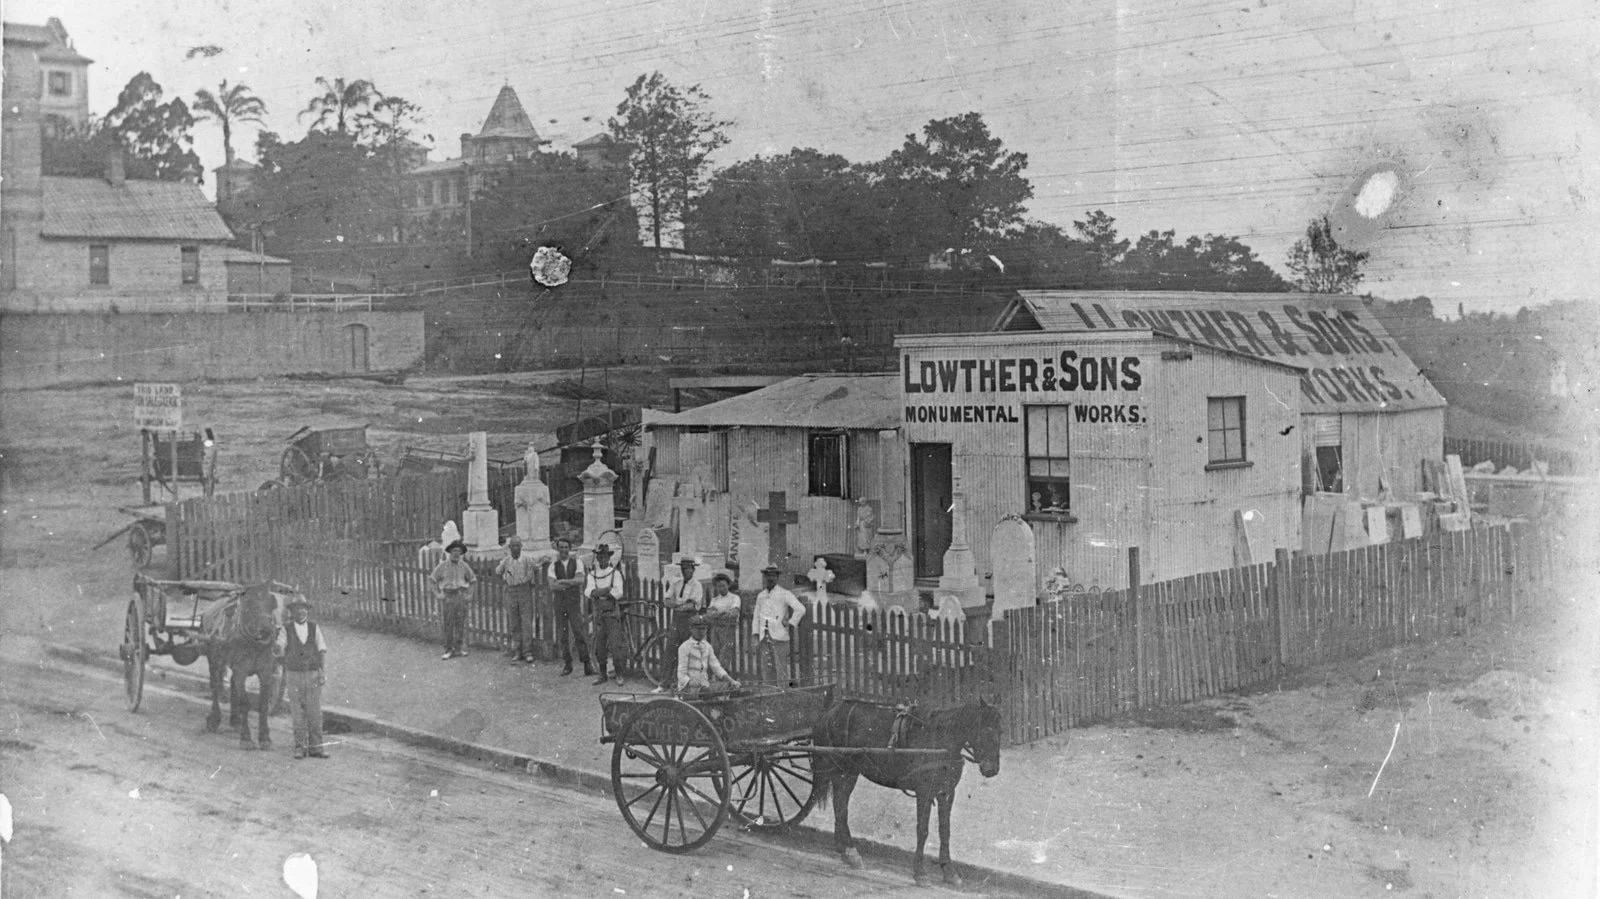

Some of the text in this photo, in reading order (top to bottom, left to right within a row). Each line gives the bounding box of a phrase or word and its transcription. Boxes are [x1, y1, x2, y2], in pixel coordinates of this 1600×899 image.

[1257, 310, 1308, 356] &
[903, 349, 1142, 393] LOWTHER & SONS
[905, 404, 1147, 424] MONUMENTAL WORKS.
